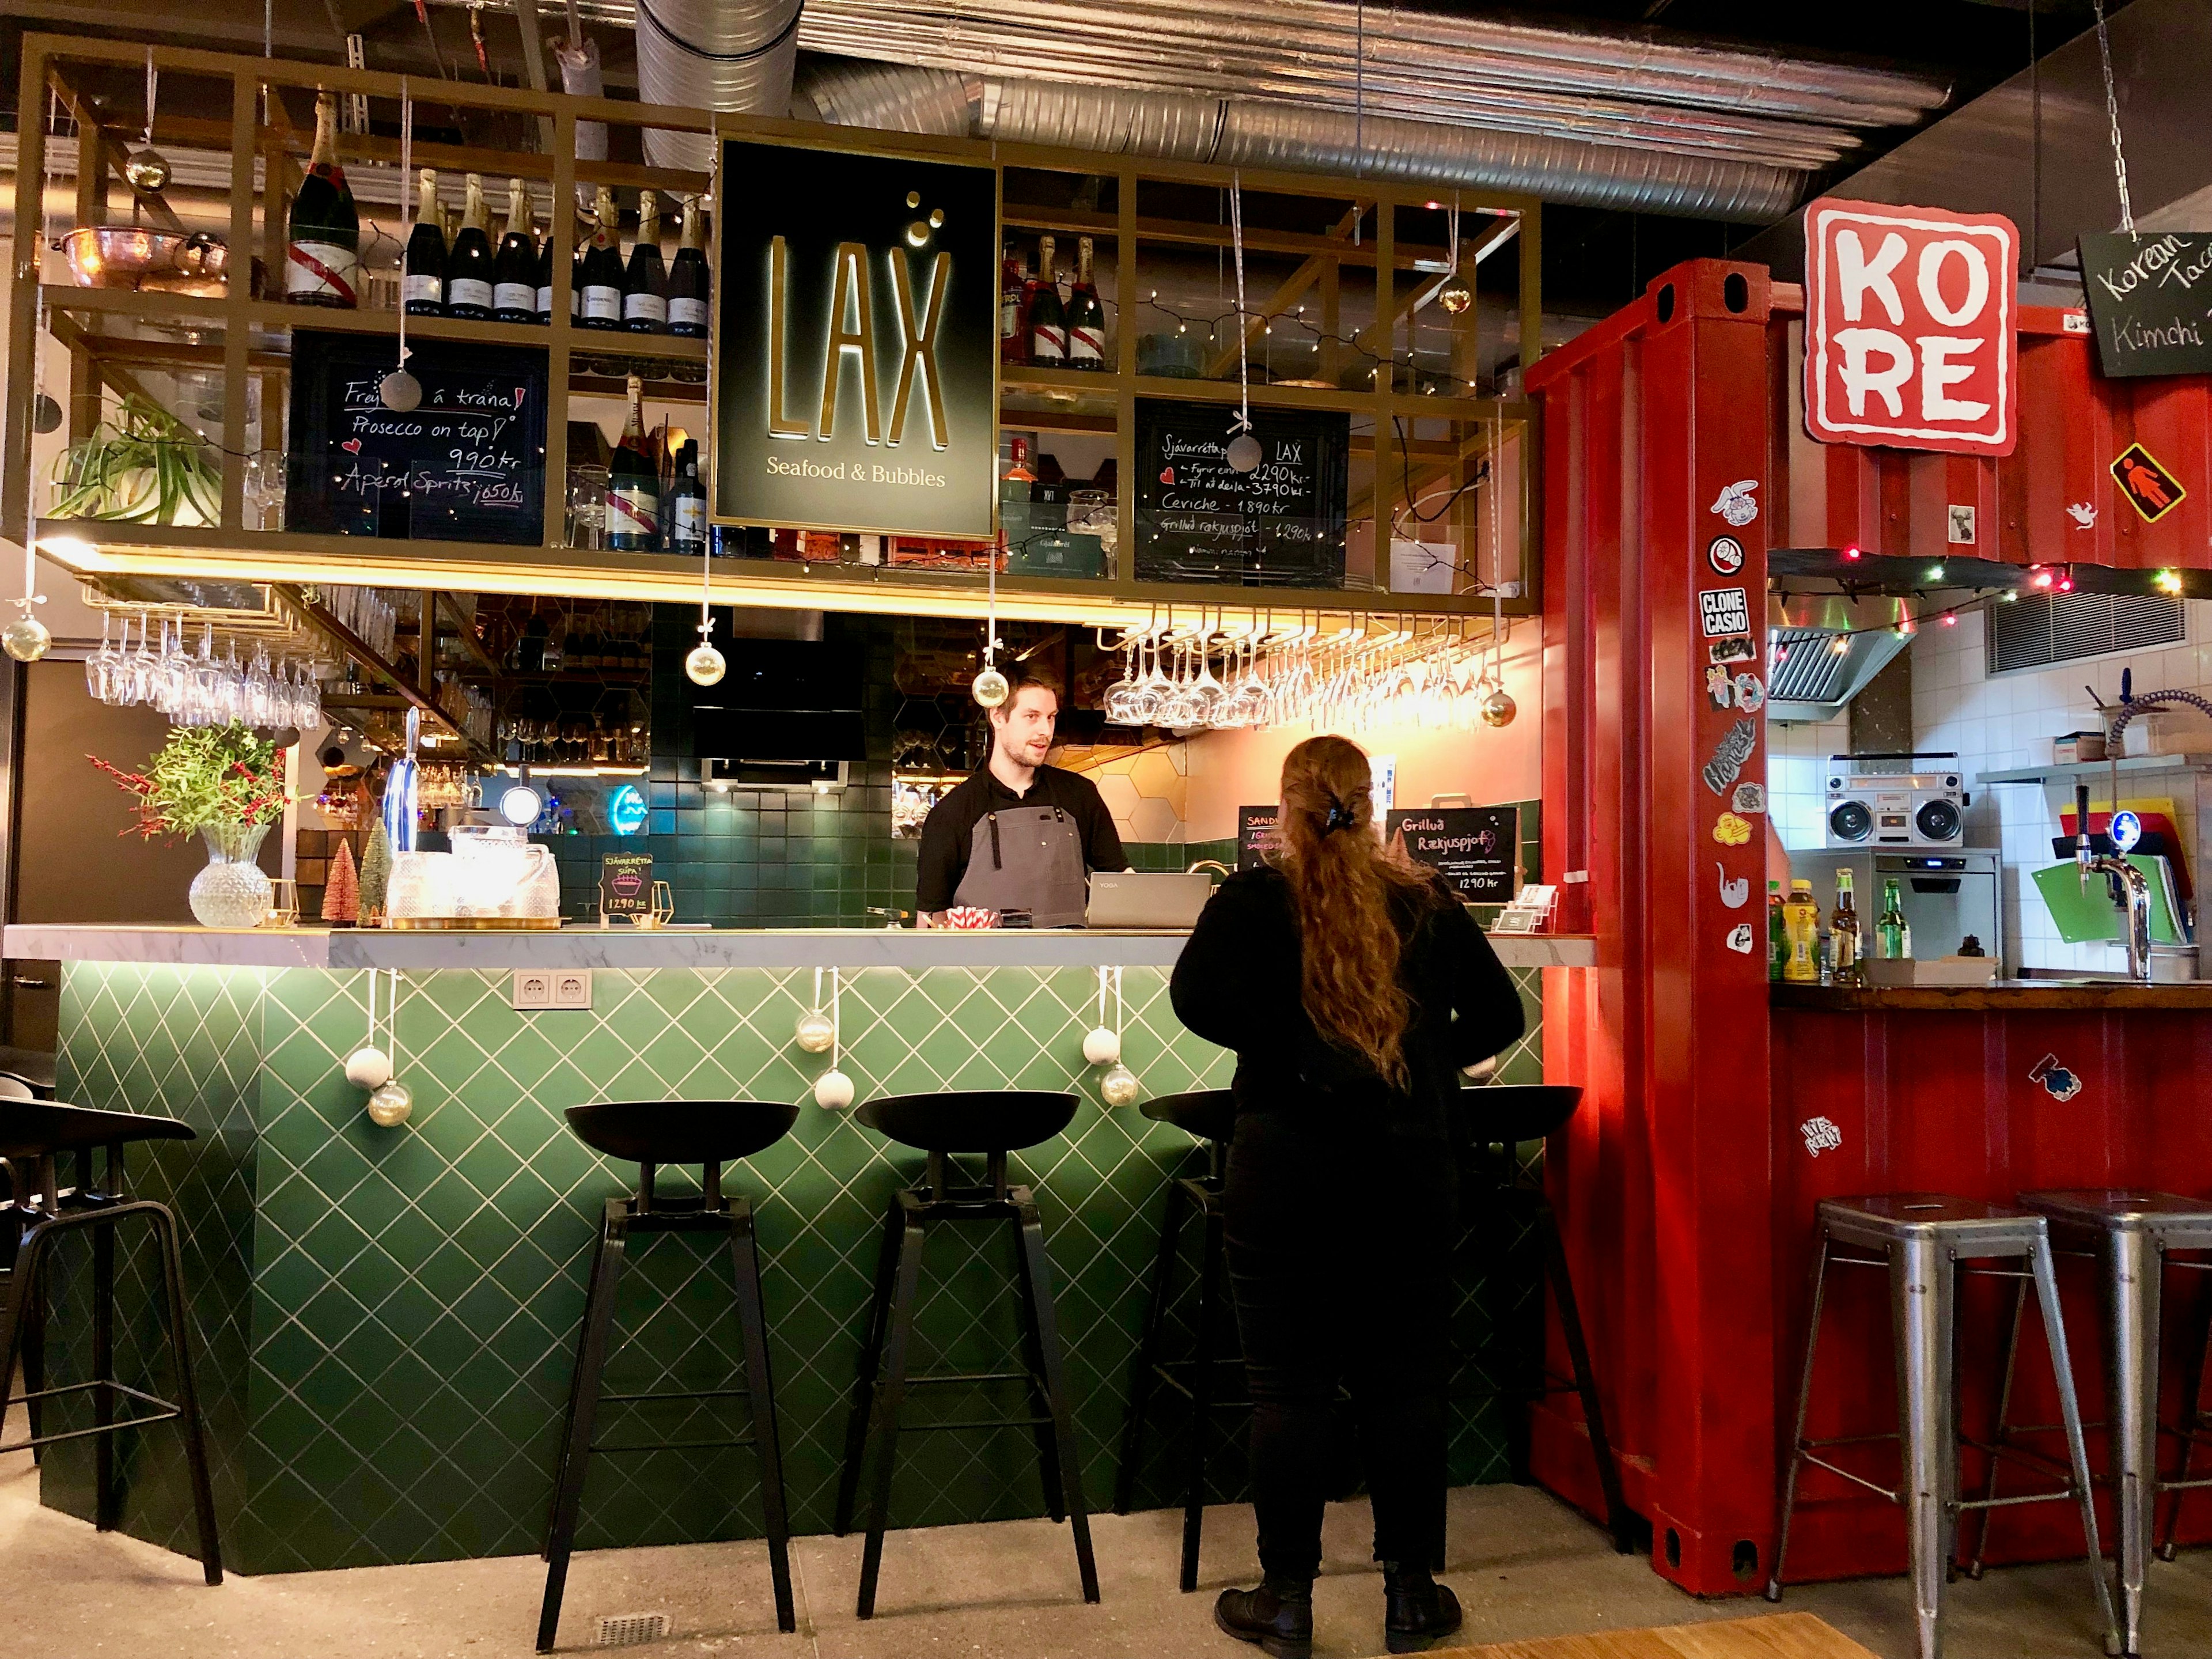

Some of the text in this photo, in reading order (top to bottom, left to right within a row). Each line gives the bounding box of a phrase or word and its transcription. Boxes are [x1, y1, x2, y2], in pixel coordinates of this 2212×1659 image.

[2097, 234, 2193, 302] Korean
[768, 234, 952, 452] LAX
[2111, 316, 2204, 353] Kimchi
[433, 389, 445, 404] á
[352, 415, 422, 435] Prosecco
[431, 426, 451, 438] on
[1161, 434, 1302, 463] Sjávarréttap LAX
[340, 462, 410, 496] Aperol
[413, 471, 472, 495] Spritz
[766, 456, 946, 488] Seafood & Bubbles
[1703, 591, 1744, 614] CLONE
[1705, 611, 1746, 634] CASIO
[1402, 818, 1445, 832] Grilluð
[1460, 877, 1485, 889] 1290
[608, 899, 635, 909] 1290
